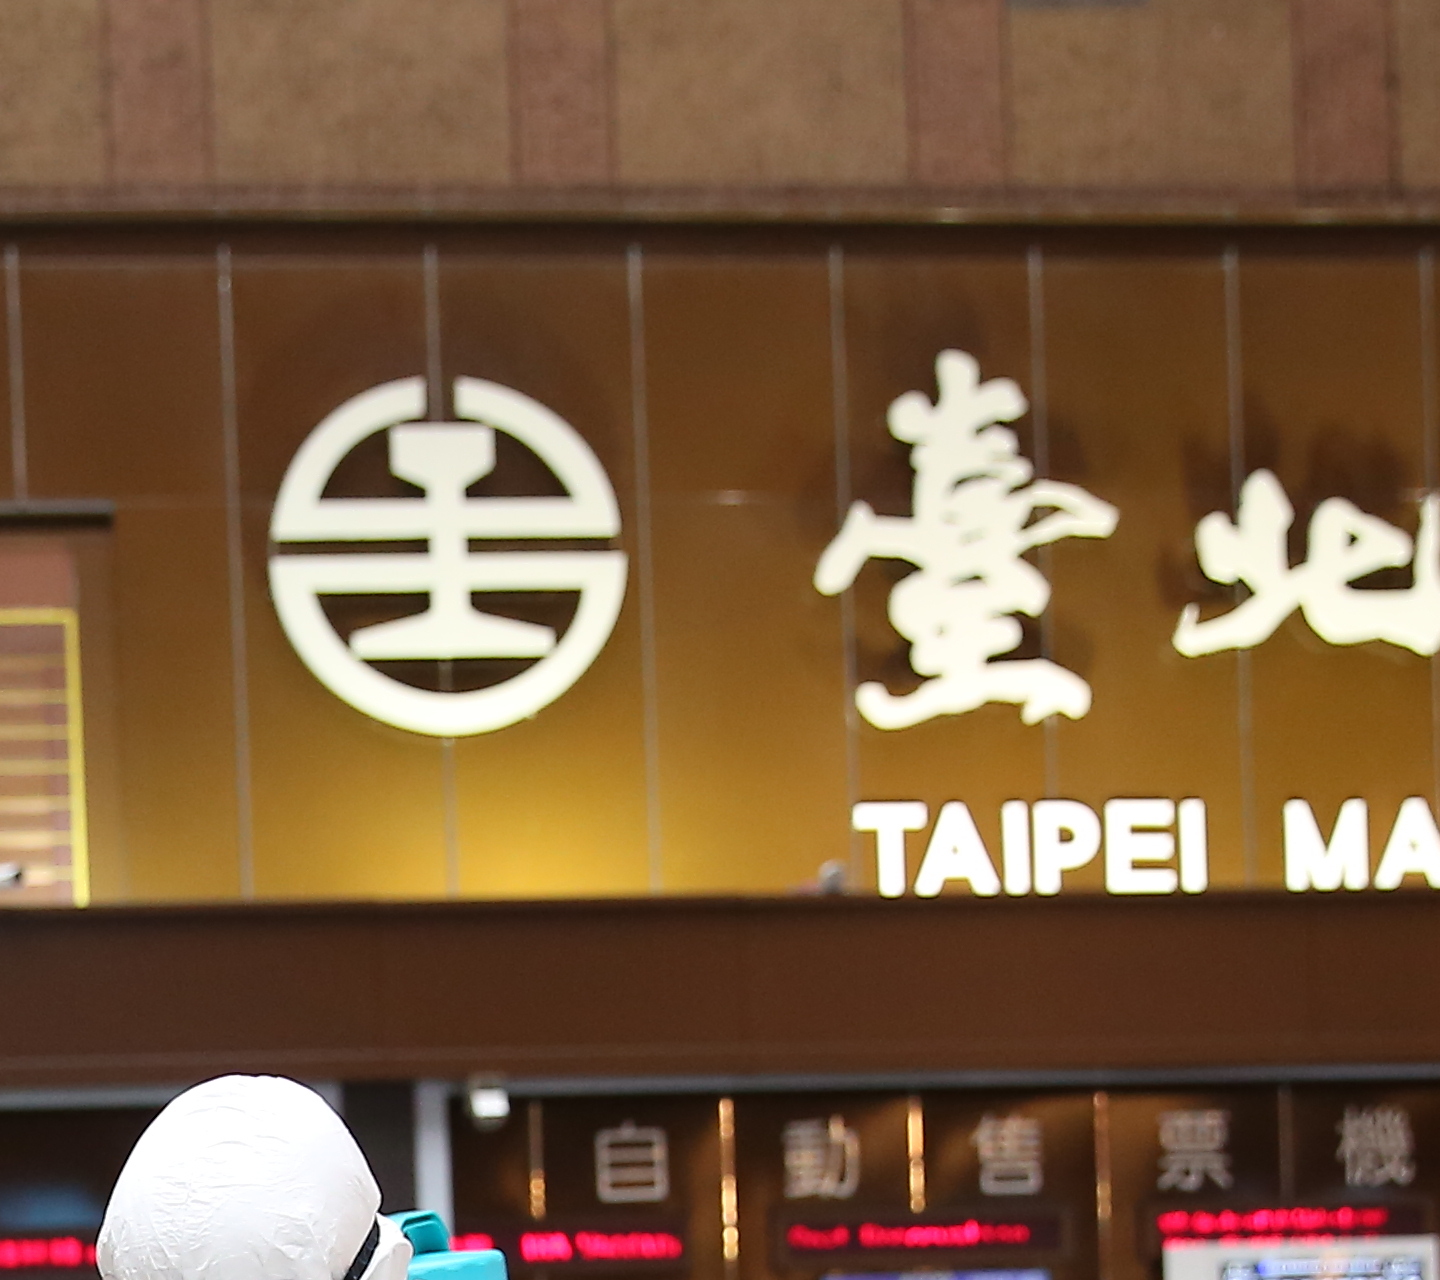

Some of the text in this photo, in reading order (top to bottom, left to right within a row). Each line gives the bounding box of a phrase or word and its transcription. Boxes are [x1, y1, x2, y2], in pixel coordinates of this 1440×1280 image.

[852, 799, 1207, 897] TAIPEI
[593, 1105, 1418, 1202] 自動售票機
